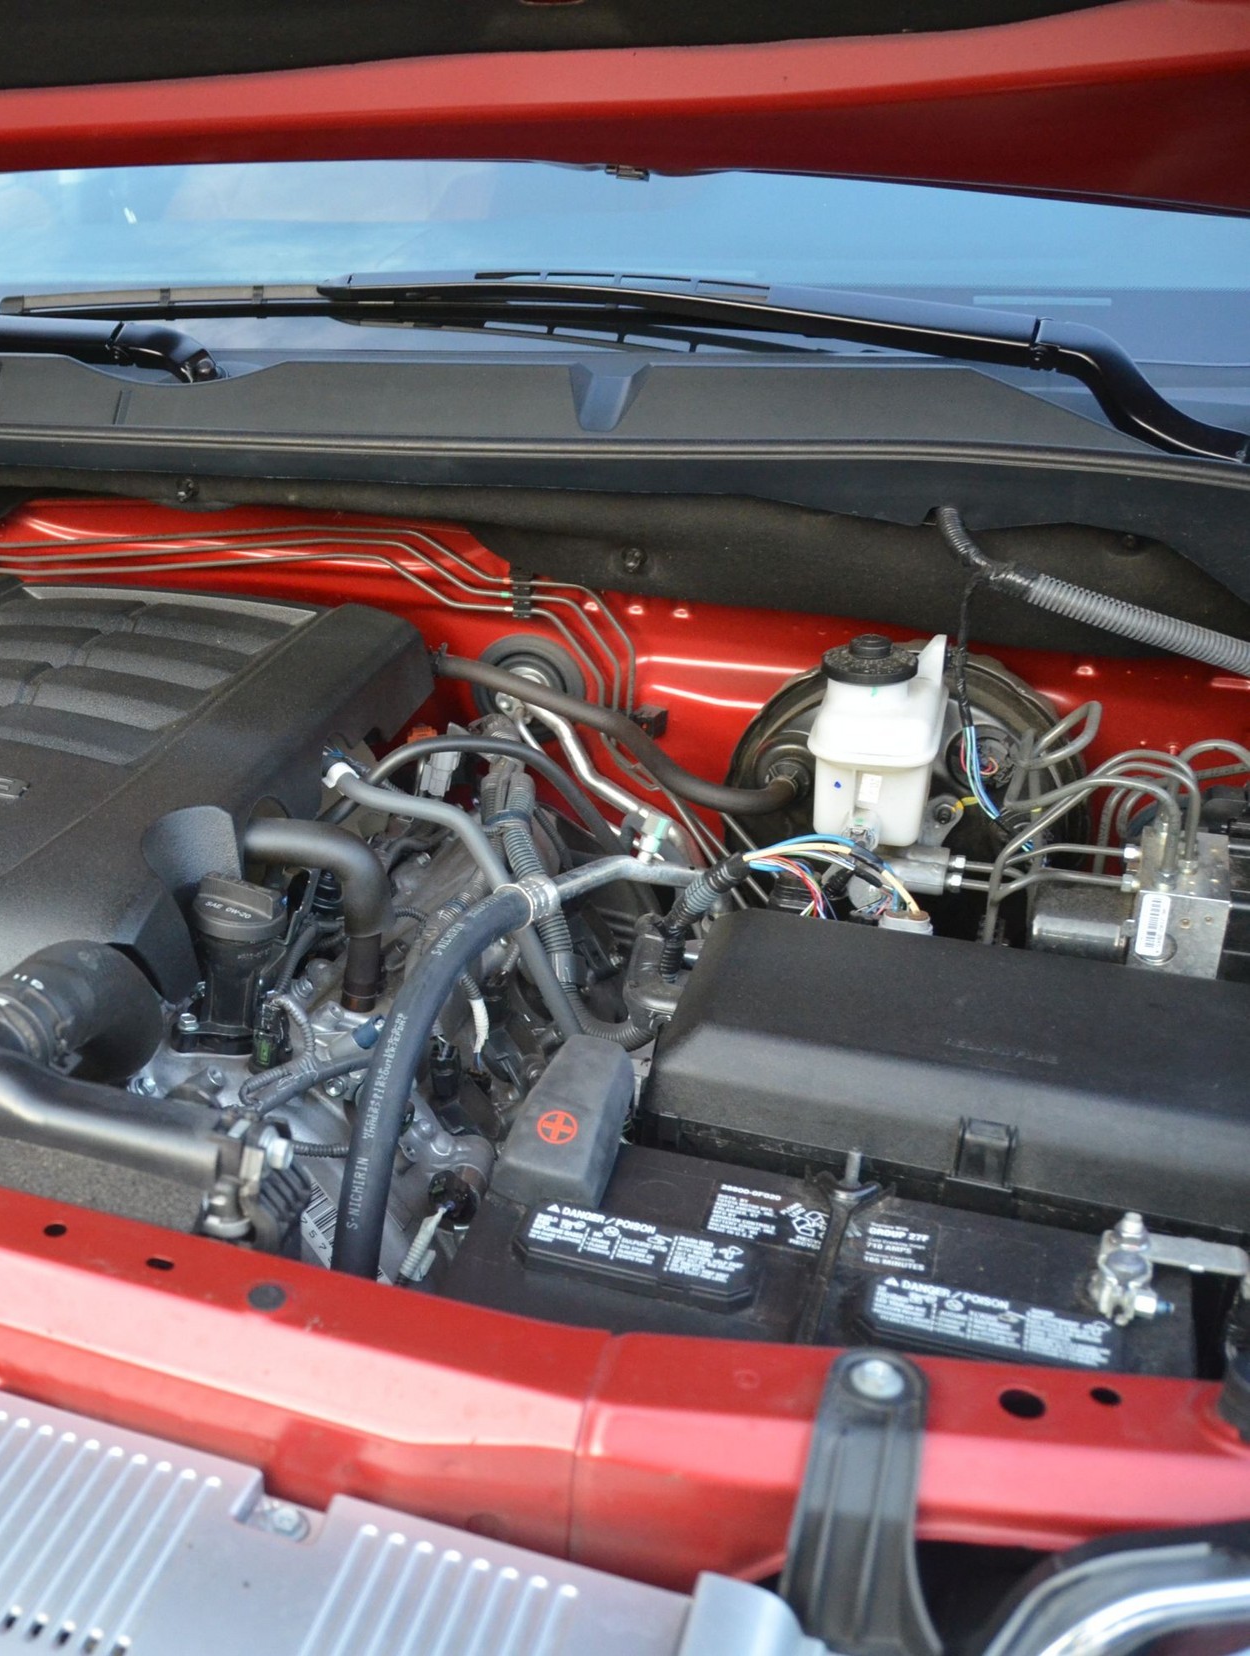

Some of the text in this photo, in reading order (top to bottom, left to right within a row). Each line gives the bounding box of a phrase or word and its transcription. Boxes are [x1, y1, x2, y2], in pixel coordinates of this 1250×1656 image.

[204, 901, 252, 919] SAE 0W-20
[561, 1206, 606, 1224] DANGER
[615, 1218, 656, 1235] POISON
[868, 1226, 930, 1242] GROUP 27F
[884, 1244, 912, 1254] AMPS
[881, 1258, 925, 1271] MINUTES
[901, 1279, 951, 1298] DANGER
[962, 1292, 1009, 1310] POISON
